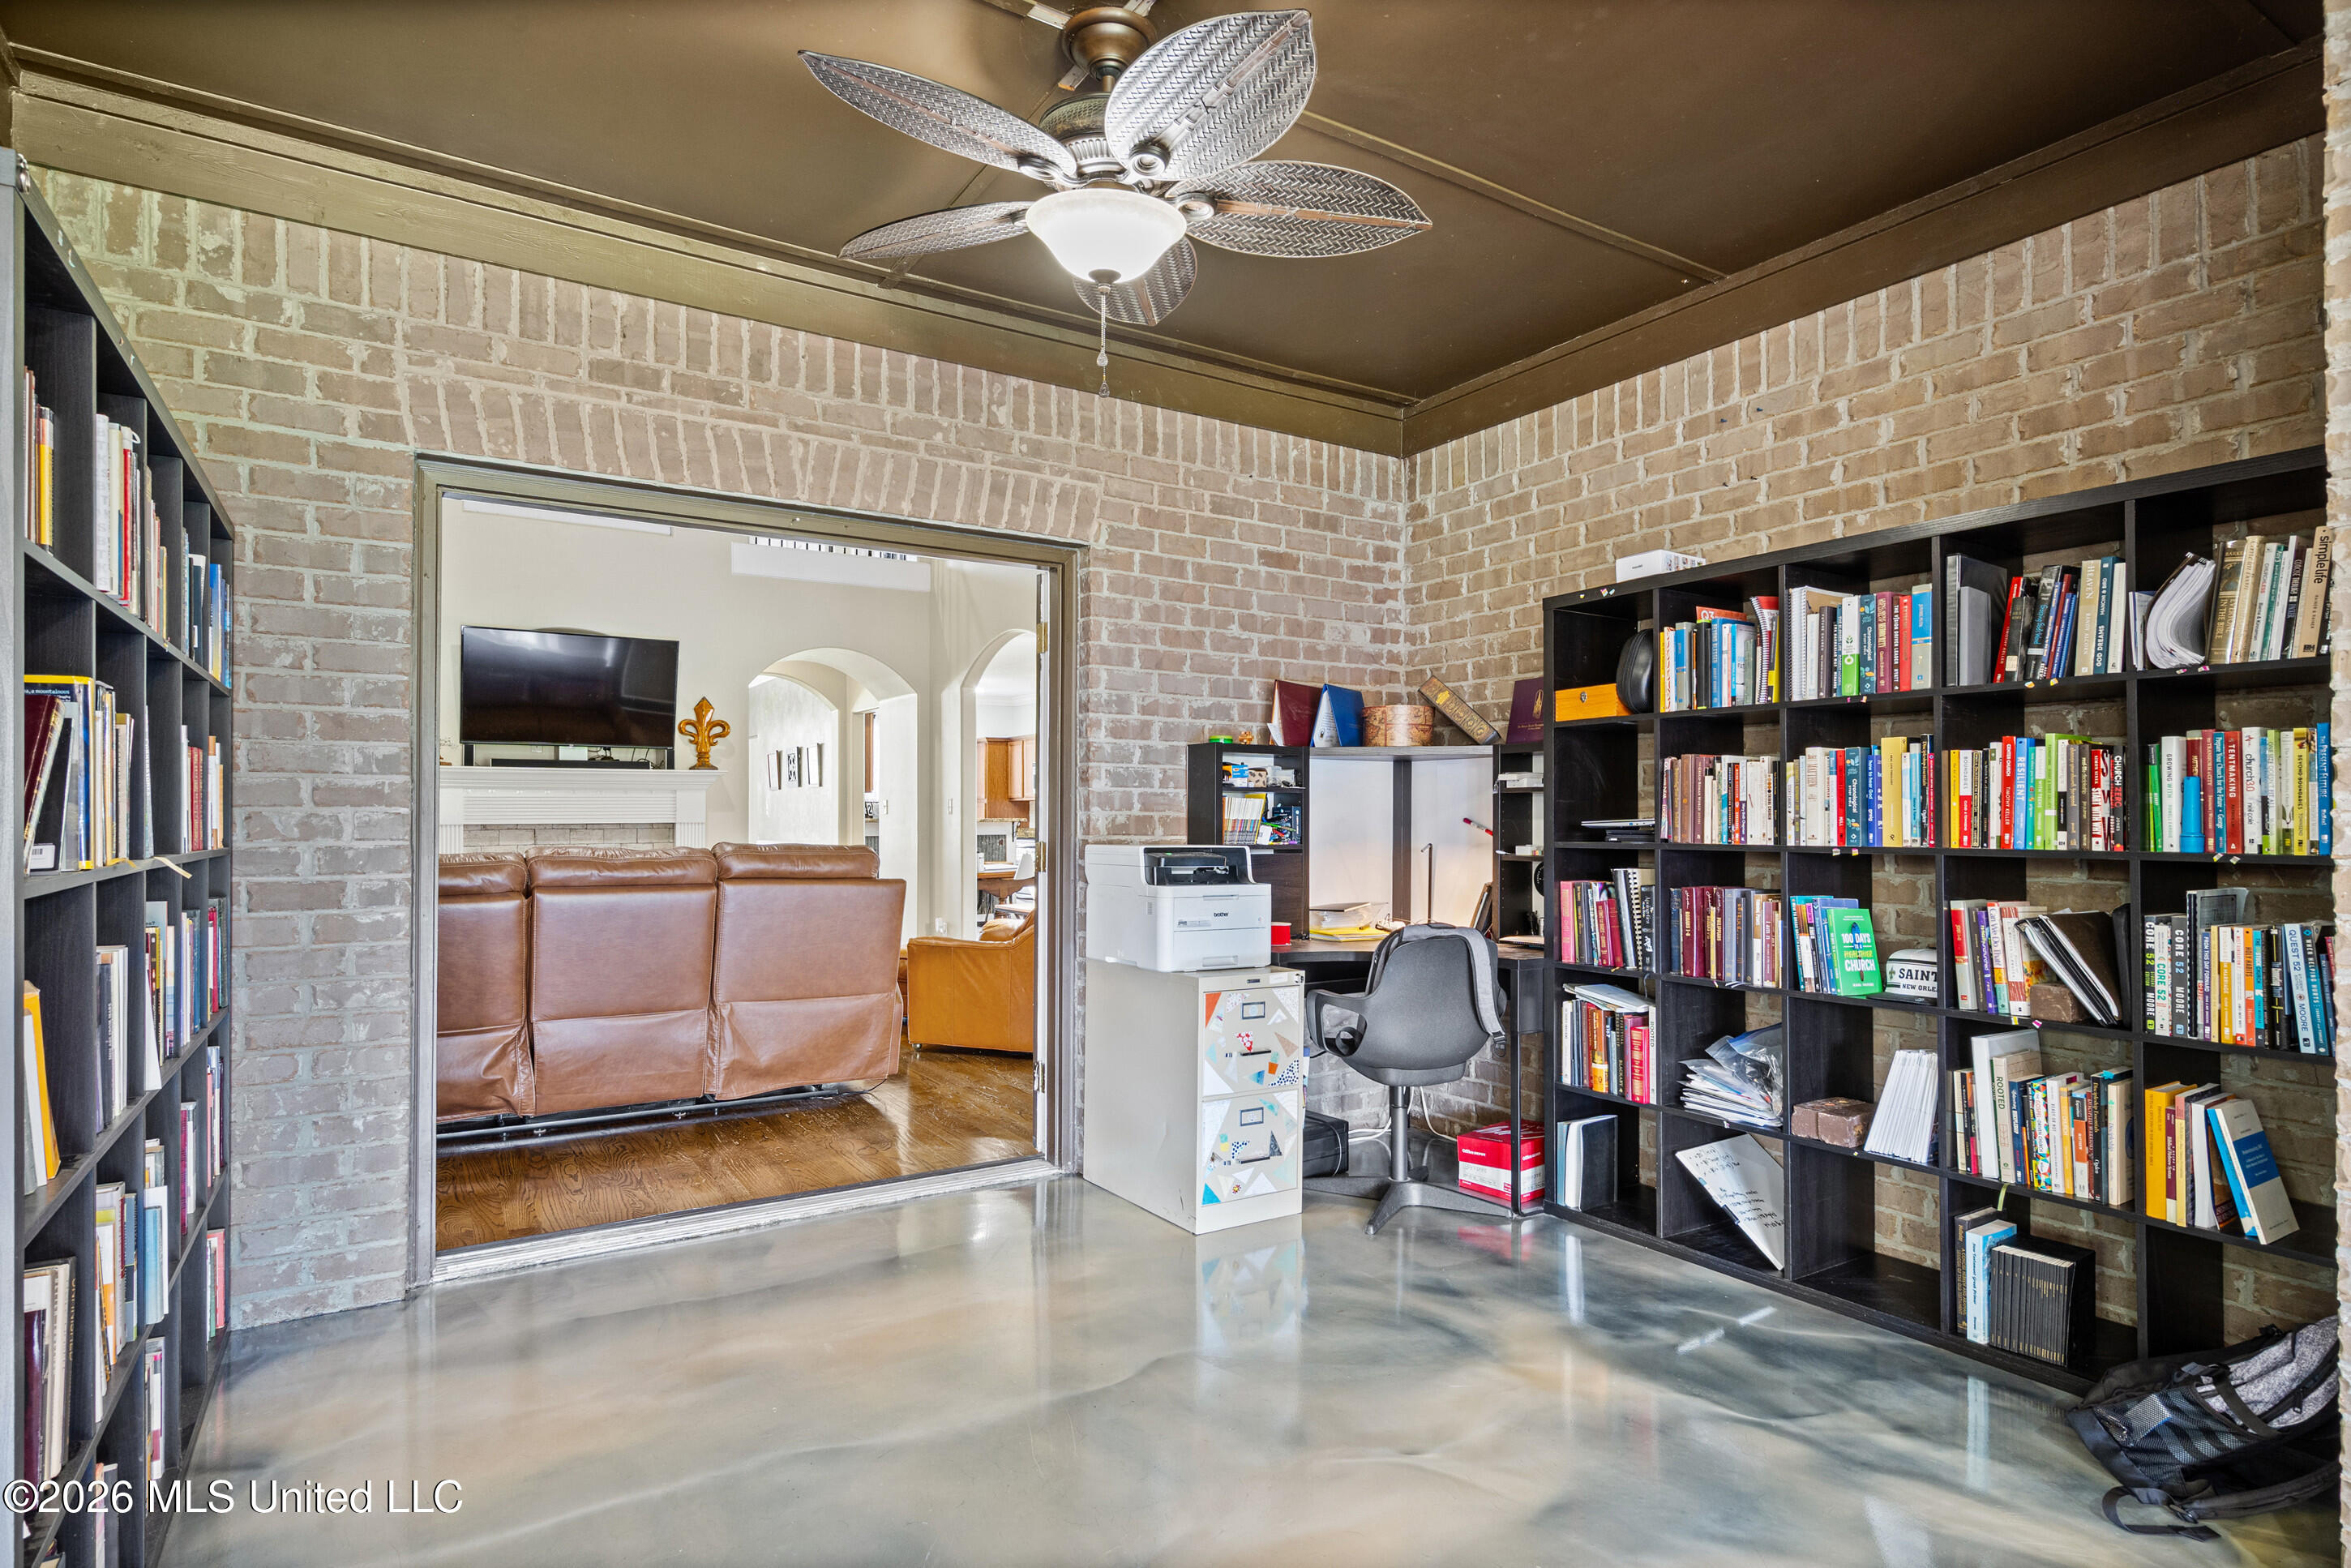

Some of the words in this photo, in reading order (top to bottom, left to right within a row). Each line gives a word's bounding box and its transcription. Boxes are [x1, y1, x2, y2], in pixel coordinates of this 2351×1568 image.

[2084, 566, 2096, 599] HEAVEN
[2260, 563, 2270, 593] CHURCHLESS
[2036, 605, 2049, 622] Grasping
[2217, 606, 2225, 621] THE
[2035, 622, 2045, 635] God's
[2215, 622, 2225, 640] BIBLE
[2033, 634, 2041, 645] Word
[2083, 633, 2091, 656] ALCORN
[2096, 625, 2105, 651] DREAMS
[2214, 737, 2223, 752] Prepare
[2319, 744, 2328, 772] PRESENT
[2016, 756, 2025, 802] RESILIENT
[2113, 755, 2122, 786] CHURCH
[2228, 744, 2236, 798] TENTMAKING
[2245, 753, 2255, 792] church3.0
[2092, 788, 2101, 806] START
[2092, 806, 2101, 821] WITH
[2216, 814, 2224, 829] George
[2092, 821, 2101, 836] WHY
[1989, 908, 1998, 923] Can
[1841, 933, 1854, 944] 100
[1855, 933, 1871, 943] DAYS
[1991, 924, 1999, 935] We
[2145, 922, 2155, 949] CORE
[1992, 936, 2000, 948] Do
[2175, 929, 2184, 957] CORE
[2288, 929, 2299, 959] QUEST
[2306, 939, 2314, 955] WHEN
[1844, 959, 1876, 972] CHURCH
[1993, 949, 2002, 966] That?
[2146, 953, 2155, 966] 52
[2293, 962, 2301, 971] 52
[1899, 968, 1937, 982] SAINT
[2156, 963, 2166, 987] CORE
[2175, 961, 2184, 974] 52
[2307, 958, 2317, 983] HELPING
[2157, 989, 2166, 1001] 52
[2175, 987, 2185, 1014] MOORE
[2311, 984, 2320, 1004] HURTS
[2146, 992, 2155, 1016] MOORE
[2298, 1003, 2309, 1032] MOORE
[1996, 1077, 2006, 1110] ROOTED
